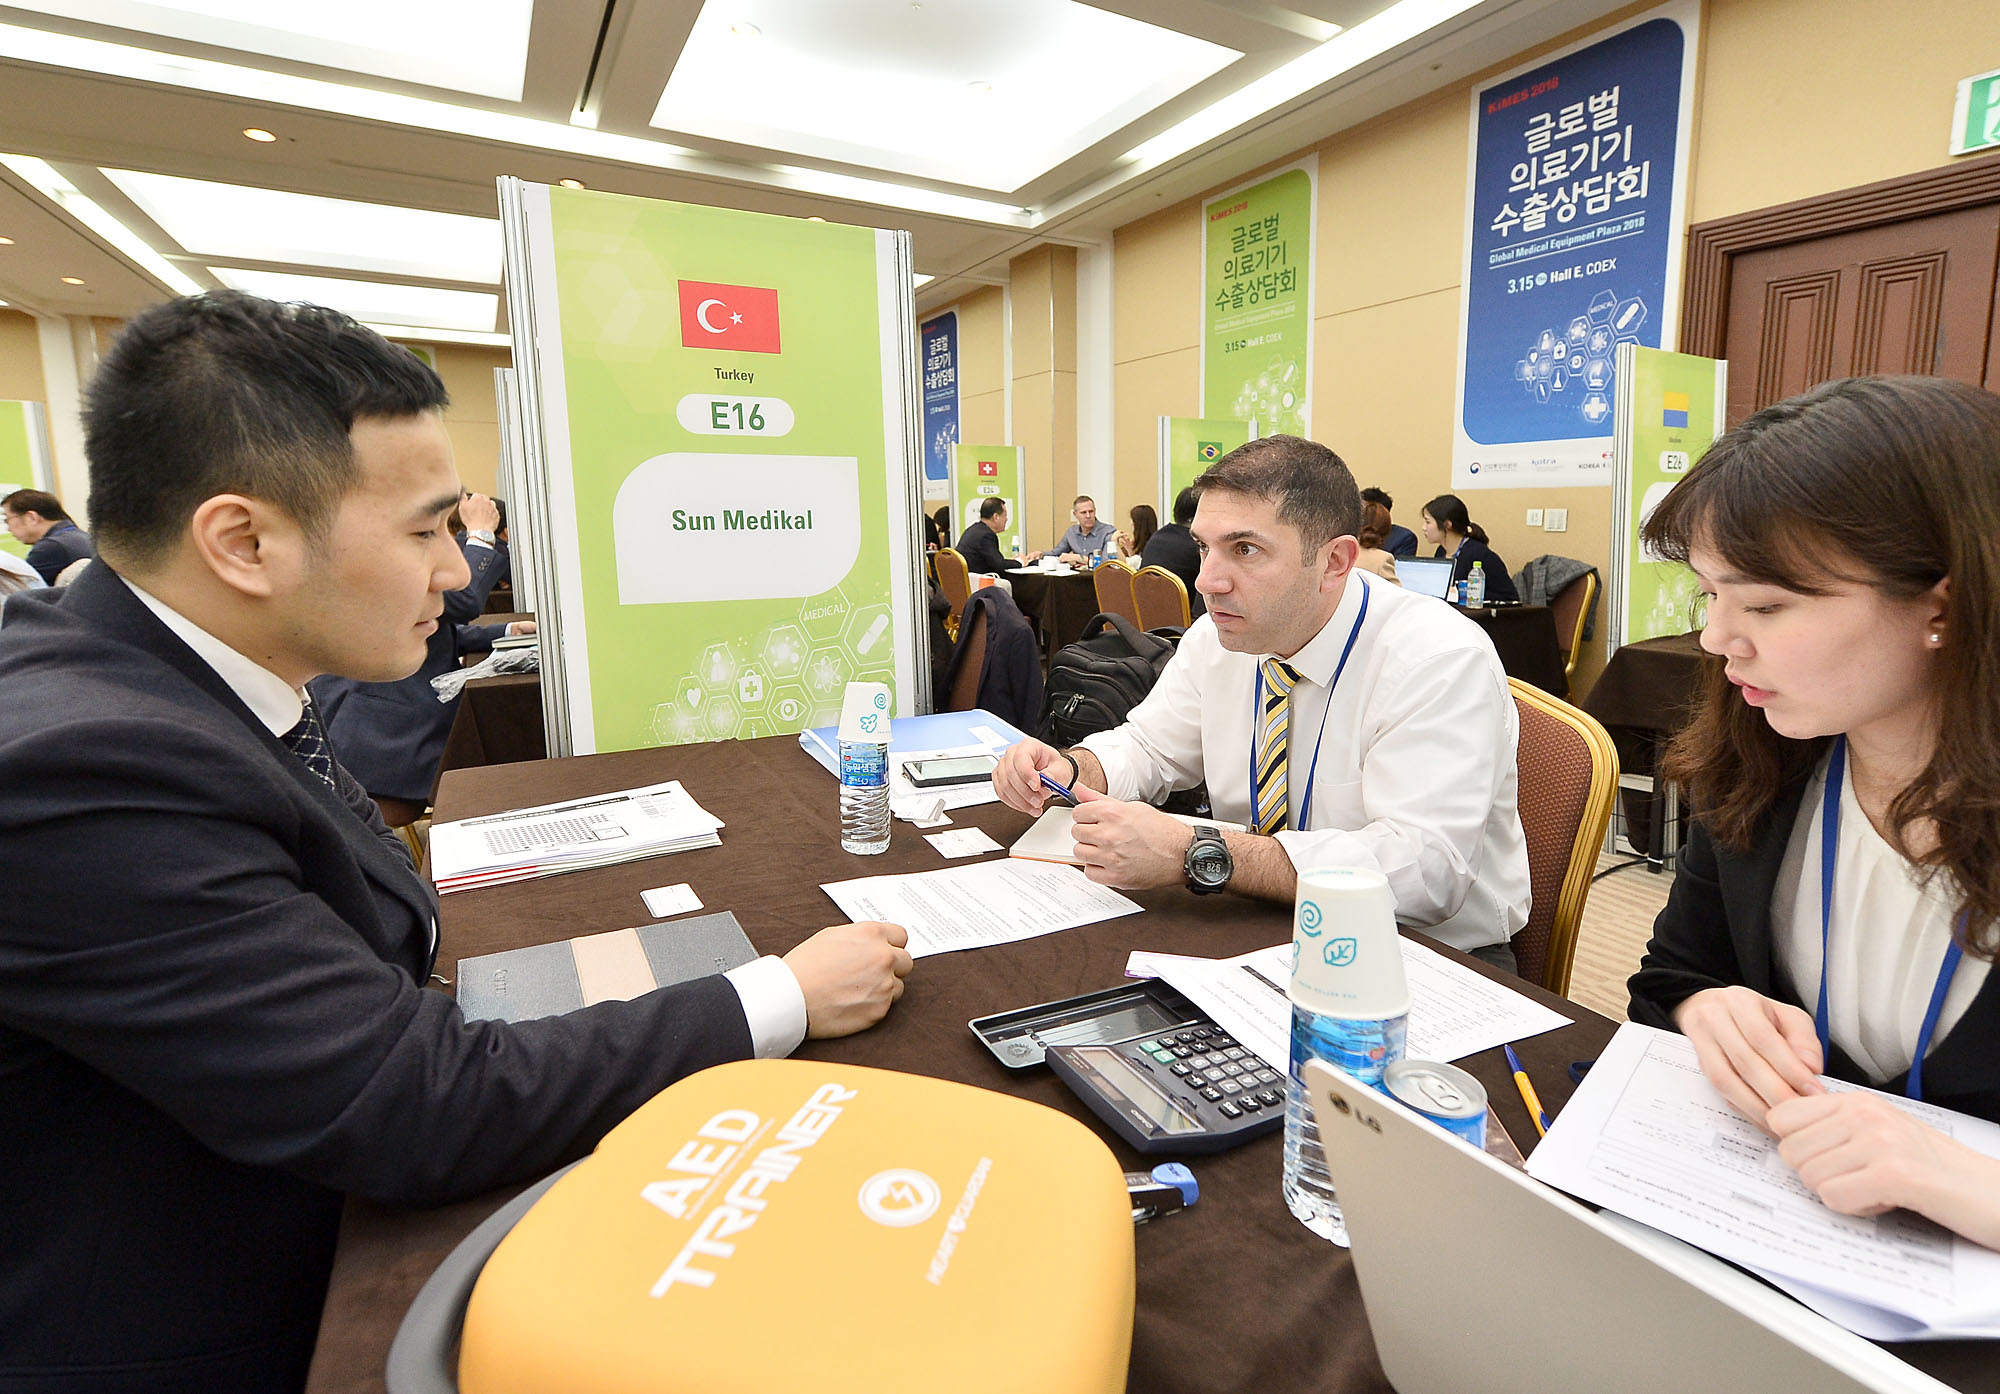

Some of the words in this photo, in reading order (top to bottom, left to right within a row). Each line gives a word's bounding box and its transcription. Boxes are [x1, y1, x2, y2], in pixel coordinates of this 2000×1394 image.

[1524, 85, 1620, 154] 글로벌
[1508, 124, 1633, 193] 의료기기
[1490, 160, 1650, 237] 수출상담회
[1231, 212, 1280, 254] 글로벌
[1489, 249, 1515, 264] Global
[1515, 240, 1549, 259] Medical
[1550, 230, 1595, 250] Equipment
[1596, 223, 1622, 238] Plaza
[1622, 216, 1646, 231] 2018
[1223, 240, 1287, 281] 의료기기
[1507, 274, 1534, 295] 3.15
[1550, 267, 1572, 284] Hall
[1573, 265, 1584, 279] E,
[1586, 257, 1617, 276] COEX
[1215, 266, 1297, 312] 수출상담회
[714, 367, 755, 384] Turkey
[711, 401, 765, 431] E16
[671, 509, 716, 531] Sun
[723, 509, 813, 531] Medikal
[803, 603, 846, 622] MEDICAL
[1355, 1107, 1383, 1134] LG
[639, 1108, 761, 1220] AED
[648, 1082, 859, 1299] TRAINER
